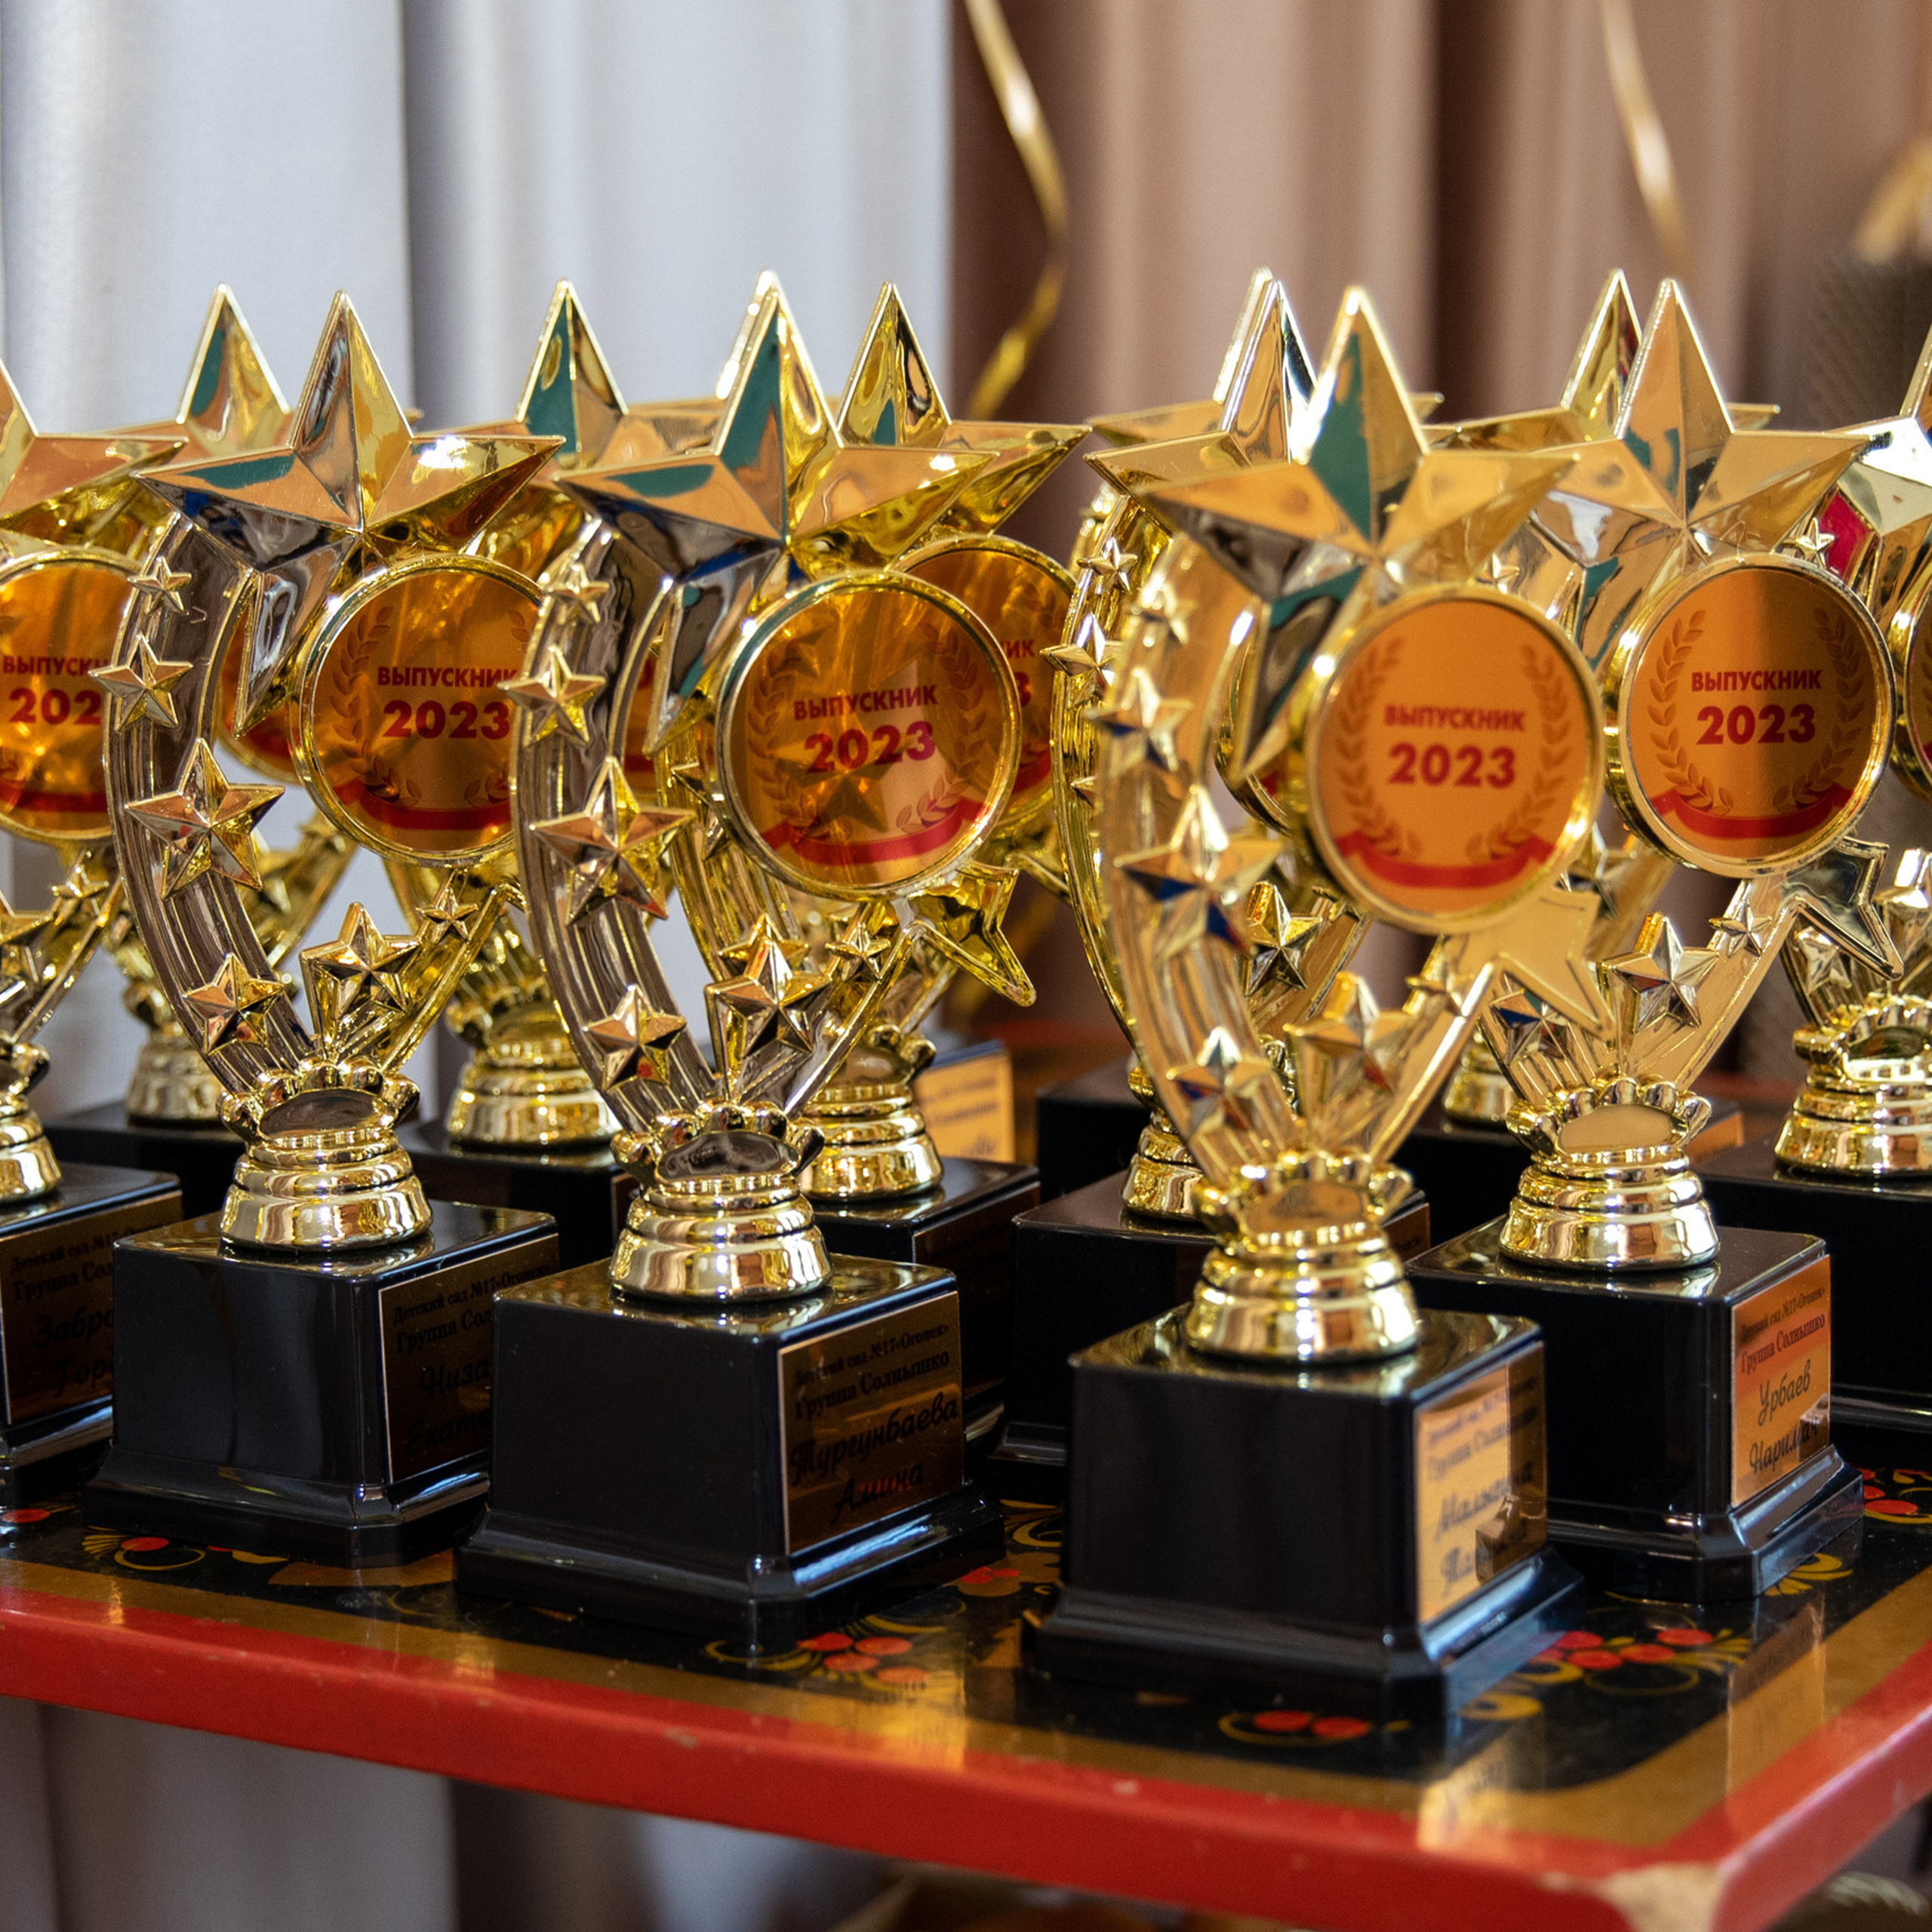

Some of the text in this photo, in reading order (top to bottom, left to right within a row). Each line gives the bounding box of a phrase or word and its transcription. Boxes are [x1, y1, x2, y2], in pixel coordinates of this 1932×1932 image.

[2, 655, 109, 676] ВЫПУСКН
[1690, 669, 1823, 693] ВЫПУСКНИК
[8, 688, 102, 725] 202
[383, 699, 510, 740] 2023
[794, 685, 937, 720] ВЫПУСКНИК
[1384, 703, 1527, 733] ВЫПУСКНИК
[1697, 703, 1817, 746] 2023
[804, 721, 936, 774] 2023
[1388, 742, 1517, 789] 2023
[13, 1269, 78, 1303] Группа
[394, 1294, 445, 1324] Детский
[448, 1288, 468, 1306] сад
[396, 1320, 457, 1354] Группа
[1740, 1313, 1825, 1375] Группа Солнышко
[420, 1358, 491, 1397] Низа
[795, 1352, 950, 1422] Группа Солнышко
[1757, 1358, 1811, 1428] Урбаев
[830, 1463, 924, 1524] Амина
